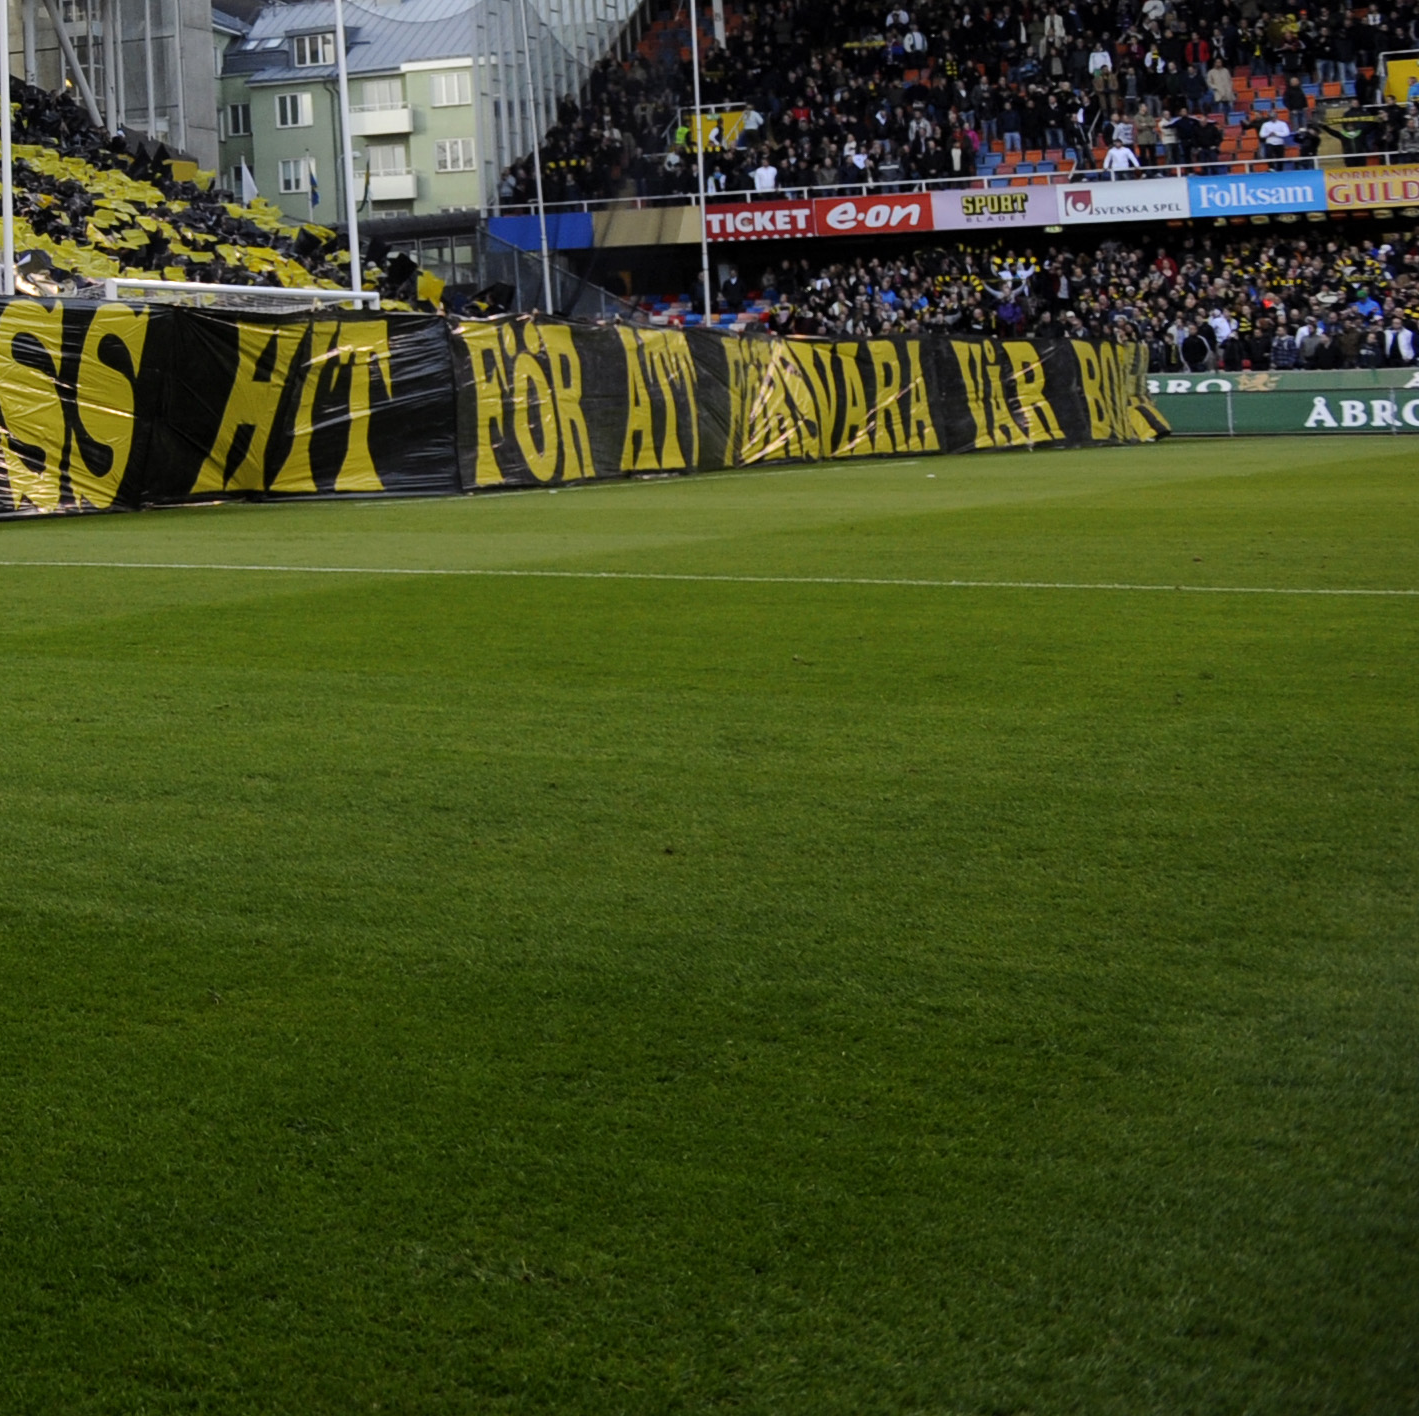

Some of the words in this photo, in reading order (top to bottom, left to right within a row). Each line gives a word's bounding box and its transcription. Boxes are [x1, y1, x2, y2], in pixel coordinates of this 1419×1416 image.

[961, 192, 1029, 216] SPORT
[1199, 182, 1314, 209] Folksam
[1328, 180, 1419, 206] GULD
[706, 208, 811, 233] TICKET
[1095, 204, 1148, 216] SVENSKA
[1153, 203, 1182, 213] SPEL
[190, 319, 392, 492] HIT
[462, 322, 596, 485] FÖR
[950, 339, 1066, 448] VÅR
